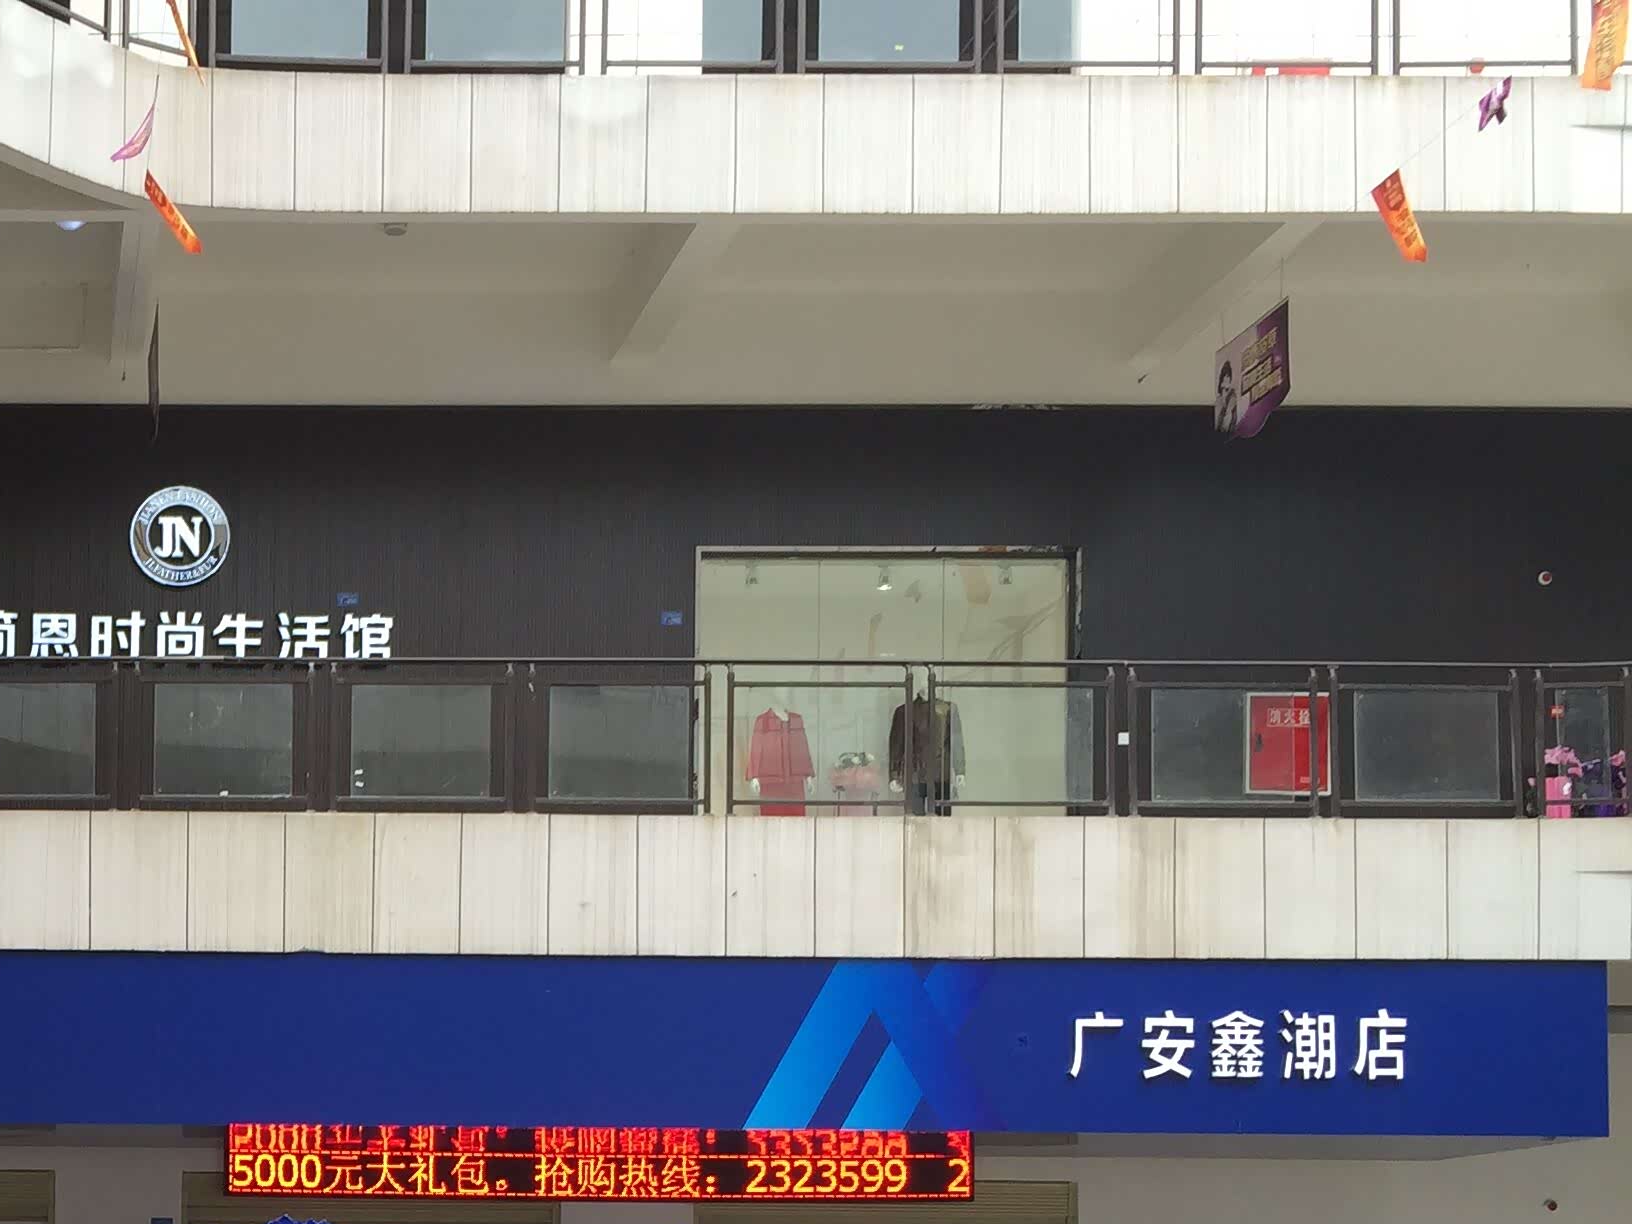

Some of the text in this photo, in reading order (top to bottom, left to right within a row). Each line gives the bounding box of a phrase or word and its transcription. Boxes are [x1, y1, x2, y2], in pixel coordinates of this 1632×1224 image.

[154, 515, 204, 558] JN
[1269, 709, 1311, 725] 消火栓
[1067, 1009, 1408, 1081] 广安鑫潮店
